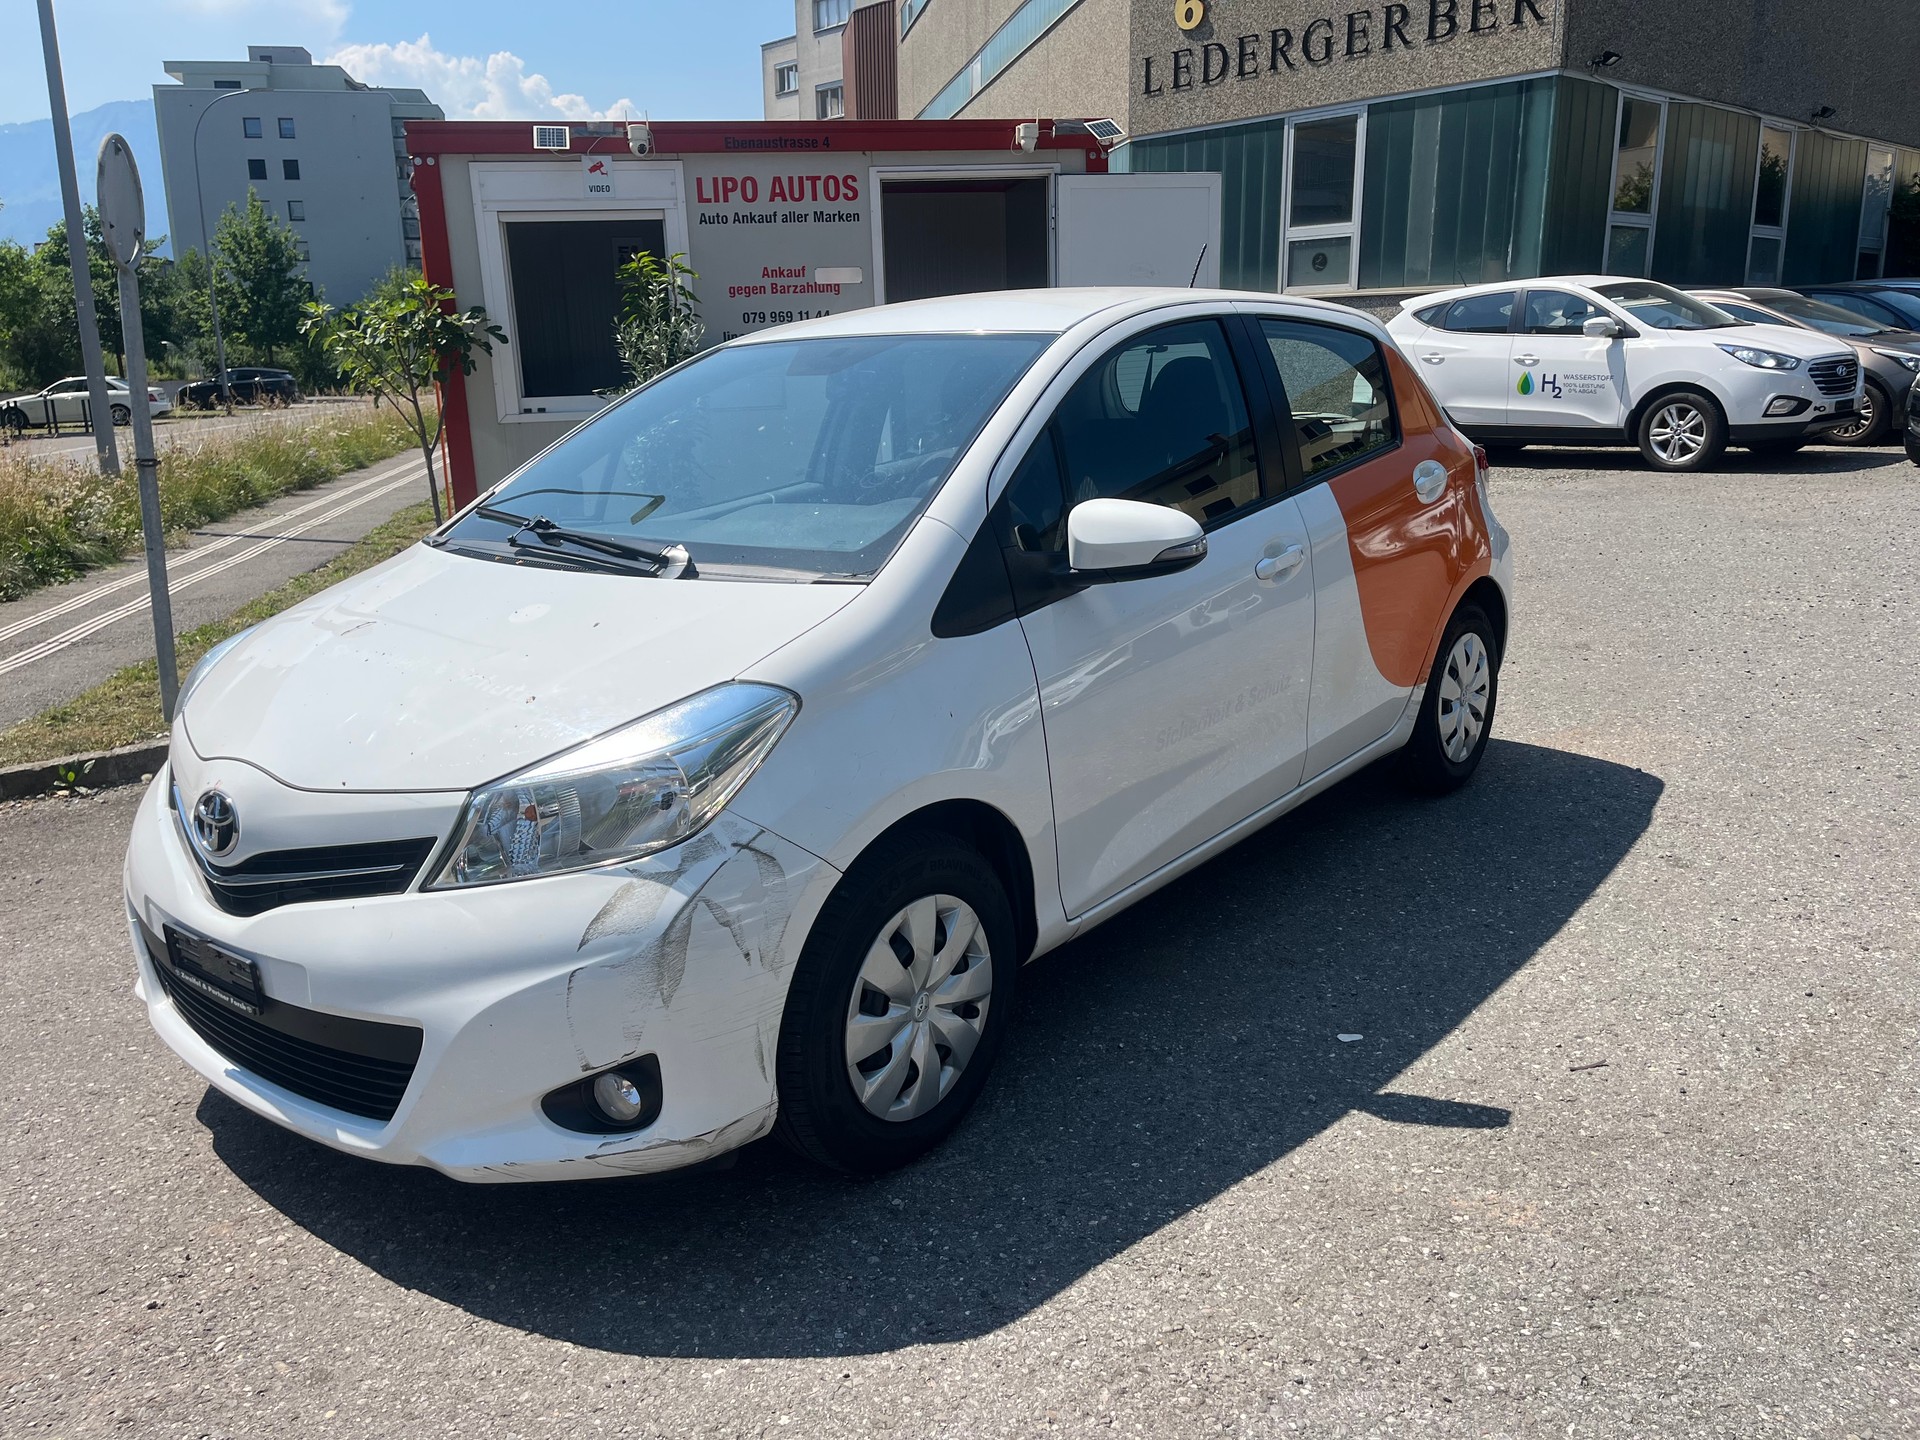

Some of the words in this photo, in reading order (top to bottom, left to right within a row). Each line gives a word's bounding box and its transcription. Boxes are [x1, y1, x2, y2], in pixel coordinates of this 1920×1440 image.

[1174, 0, 1204, 30] 6
[724, 137, 818, 149] Ebenaustrasse
[822, 137, 830, 148] 4
[588, 185, 611, 193] VIDEO
[696, 176, 758, 203] LIPO
[769, 175, 859, 202] AUTOS
[699, 213, 728, 225] Auto
[732, 211, 777, 224] Ankauf
[781, 211, 809, 223] aller
[813, 210, 860, 223] Marken
[762, 266, 806, 279] Ankauf
[728, 285, 766, 298] gegen
[770, 282, 840, 296] Barzahlung
[743, 311, 766, 324] 079
[770, 310, 793, 323] 969
